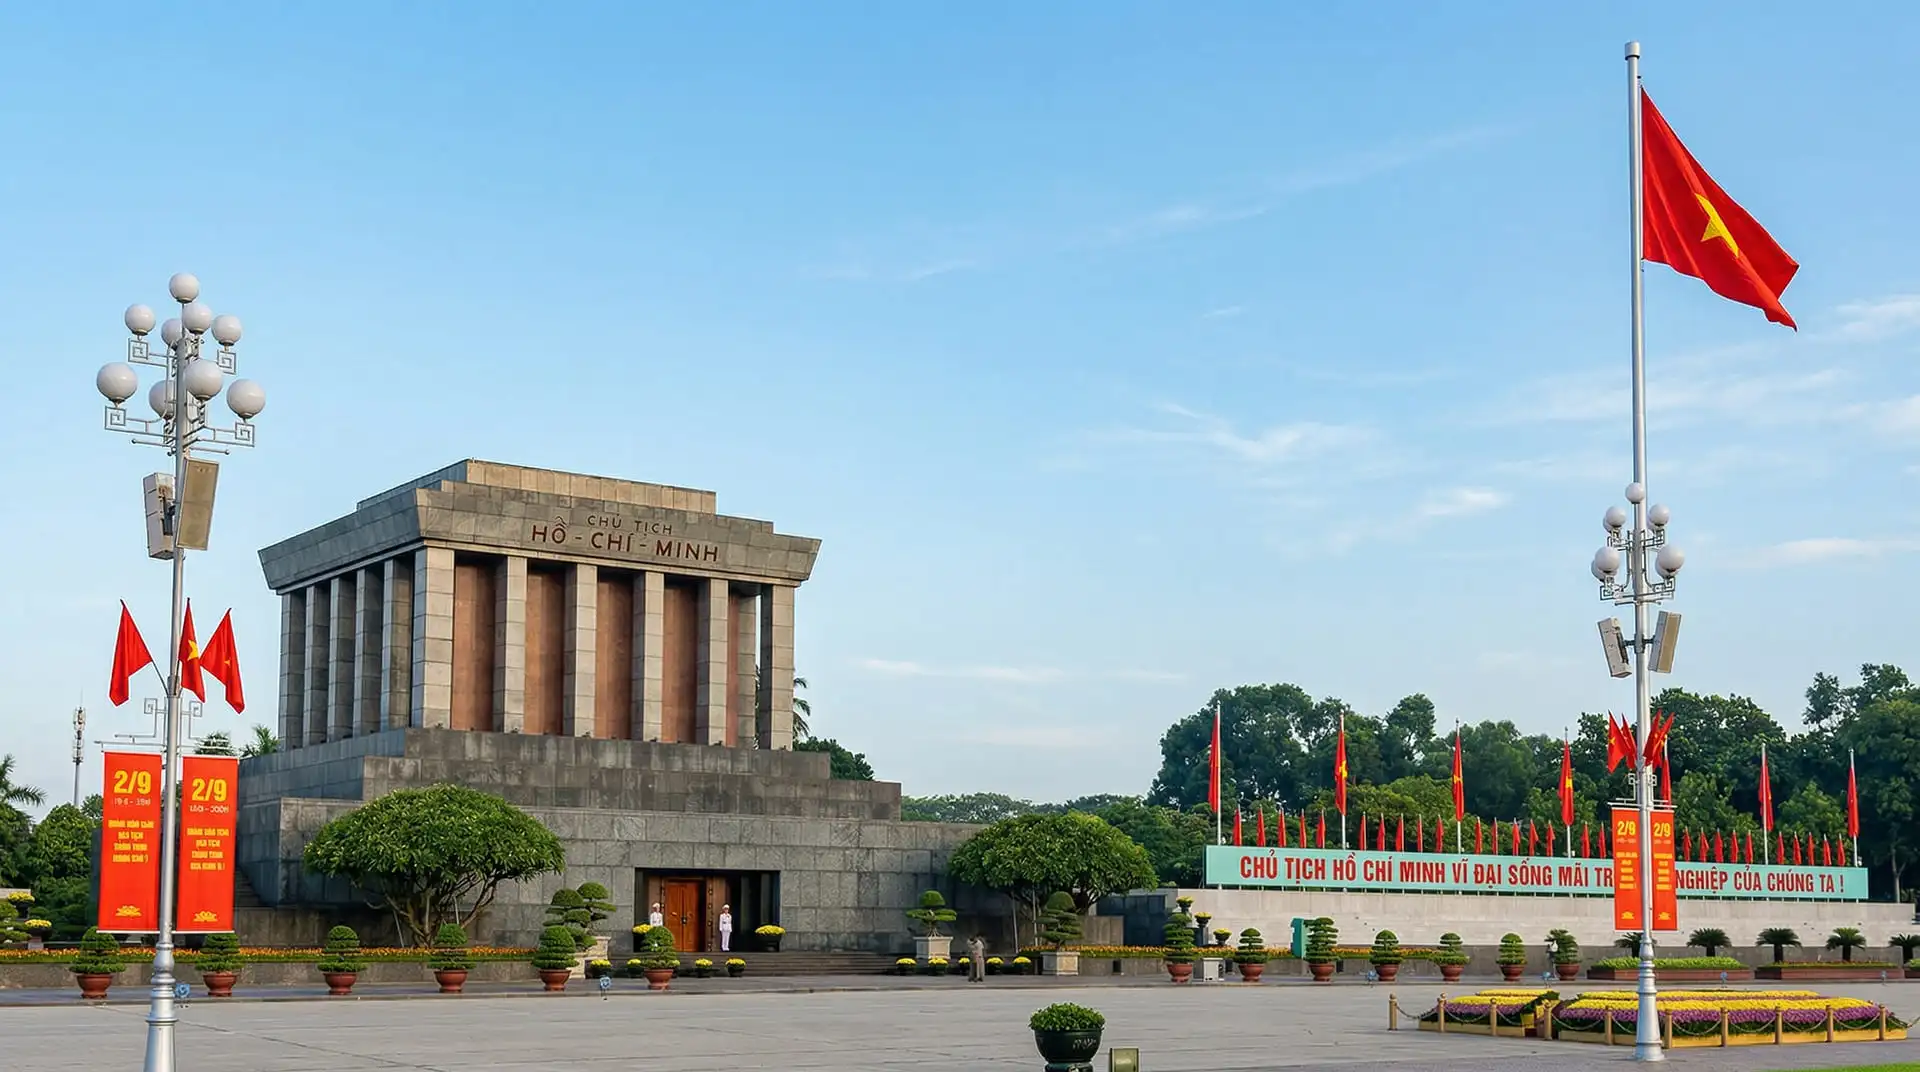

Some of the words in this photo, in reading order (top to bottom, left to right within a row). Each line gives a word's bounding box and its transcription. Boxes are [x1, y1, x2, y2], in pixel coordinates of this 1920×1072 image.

[587, 513, 622, 528] CHỦ
[634, 520, 672, 537] TỊCH
[532, 516, 567, 544] HỒ
[591, 532, 634, 553] CHÍ
[656, 539, 718, 562] MINH
[113, 770, 152, 795] 2/9
[191, 778, 227, 802] 2/9
[1617, 820, 1636, 835] 2/9
[1653, 822, 1671, 837] 2/9
[1240, 849, 1277, 879] CHỦ
[1284, 857, 1326, 884] TỊCH
[1333, 851, 1357, 881] HỒ
[1363, 856, 1392, 882] CHÍ
[1399, 861, 1446, 883] MINH
[1452, 858, 1469, 883] VĨ
[1473, 863, 1501, 888] ĐẠI
[1508, 857, 1553, 886] SỐNG
[1558, 862, 1588, 887] MÃI
[1675, 866, 1728, 894] NGHIỆP
[1734, 865, 1762, 891] CỦA
[1767, 868, 1814, 893] CHÚNG
[1819, 874, 1835, 893] TA
